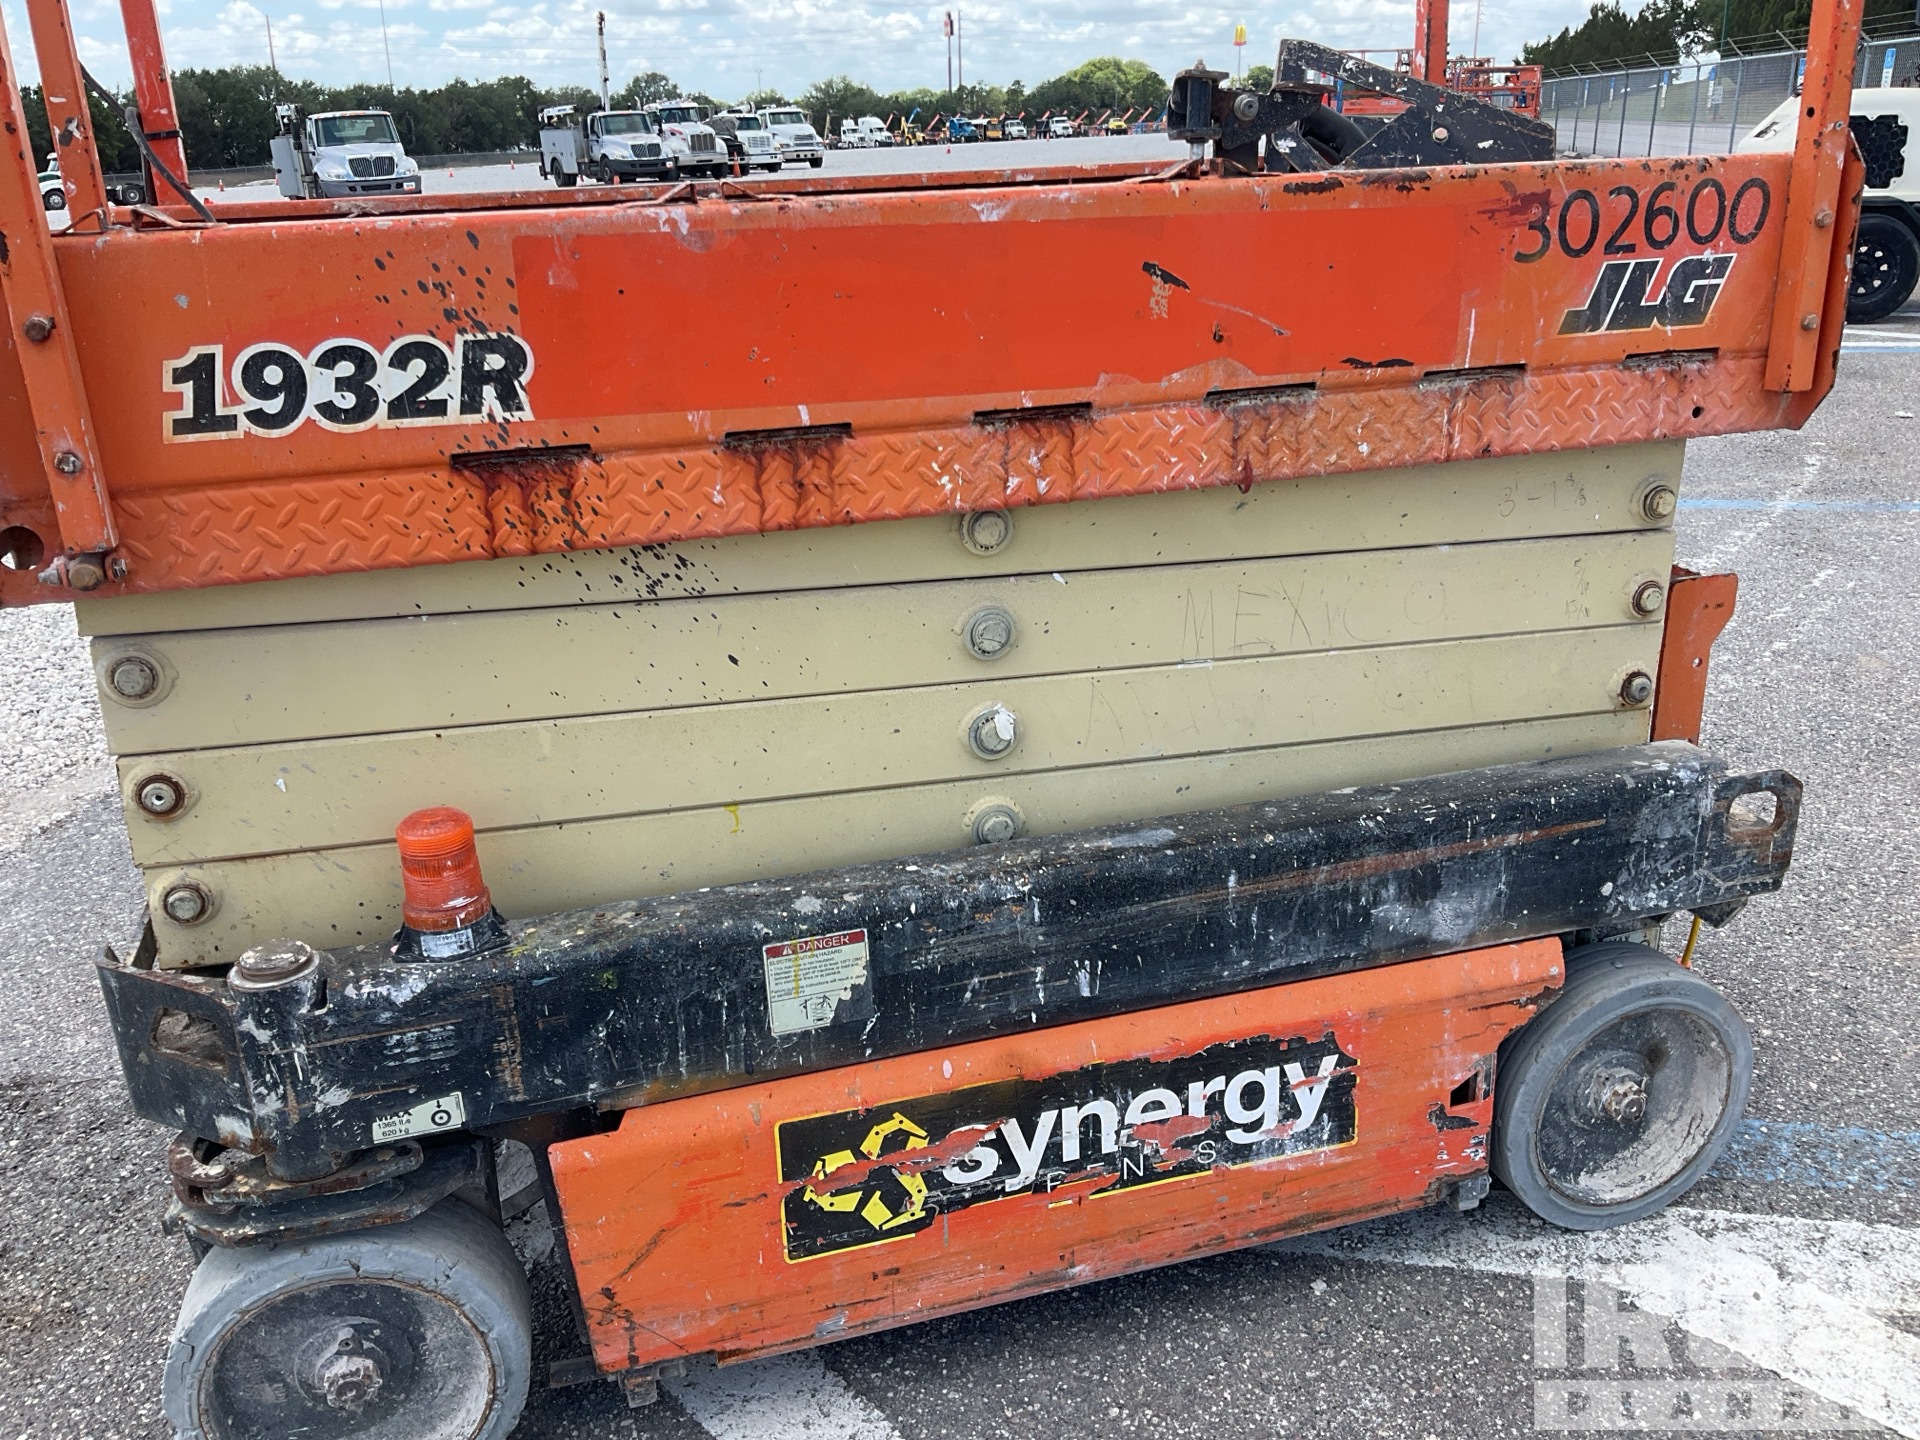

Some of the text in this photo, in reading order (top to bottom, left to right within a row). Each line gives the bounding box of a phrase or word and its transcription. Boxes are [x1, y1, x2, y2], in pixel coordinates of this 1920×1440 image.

[1513, 177, 1771, 263] 302600
[1557, 253, 1737, 336] JLG
[163, 333, 535, 444] 1932R
[797, 935, 850, 952] DANGER
[818, 949, 843, 957] HAZARD
[378, 1121, 397, 1129] 1365
[382, 1128, 397, 1137] 620
[942, 1054, 1340, 1192] synergy
